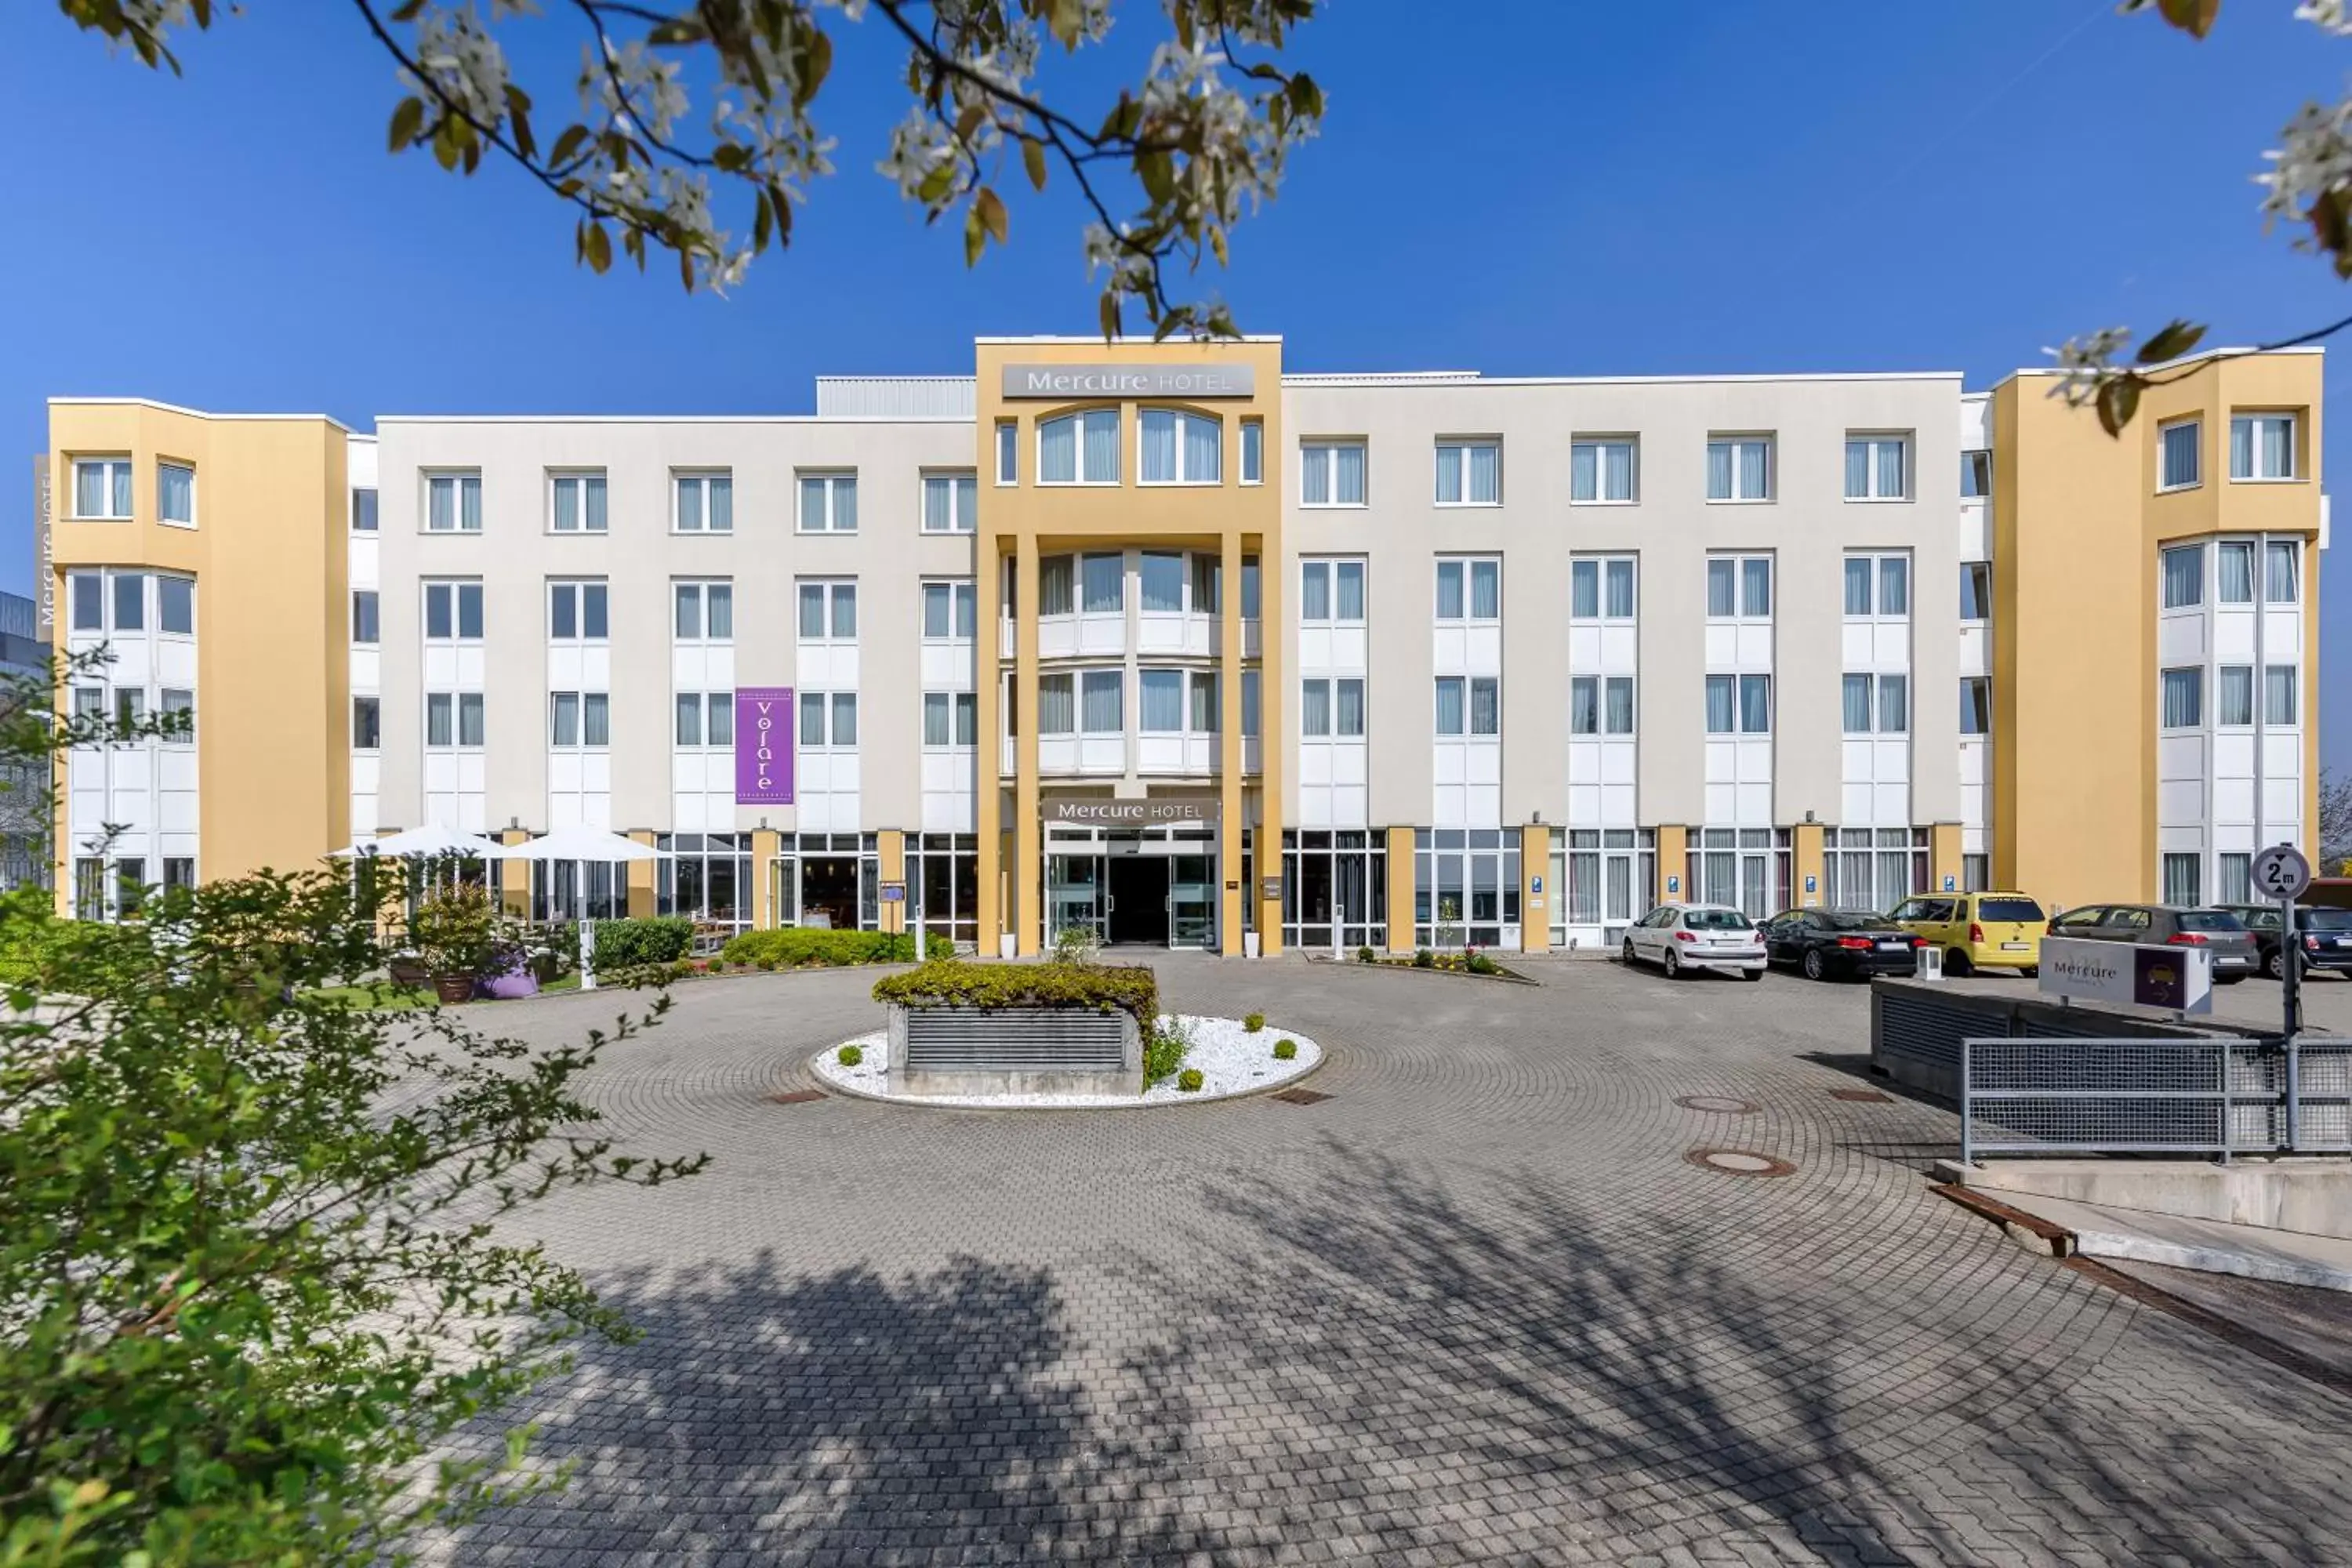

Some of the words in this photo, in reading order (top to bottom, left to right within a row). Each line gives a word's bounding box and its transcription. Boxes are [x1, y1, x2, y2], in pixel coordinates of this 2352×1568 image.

[1028, 372, 1149, 390] Mercure
[1159, 374, 1234, 390] HOTEL
[1058, 804, 1144, 818] Mercure
[1151, 805, 1204, 818] HOTEL
[2054, 961, 2117, 979] Mercure
